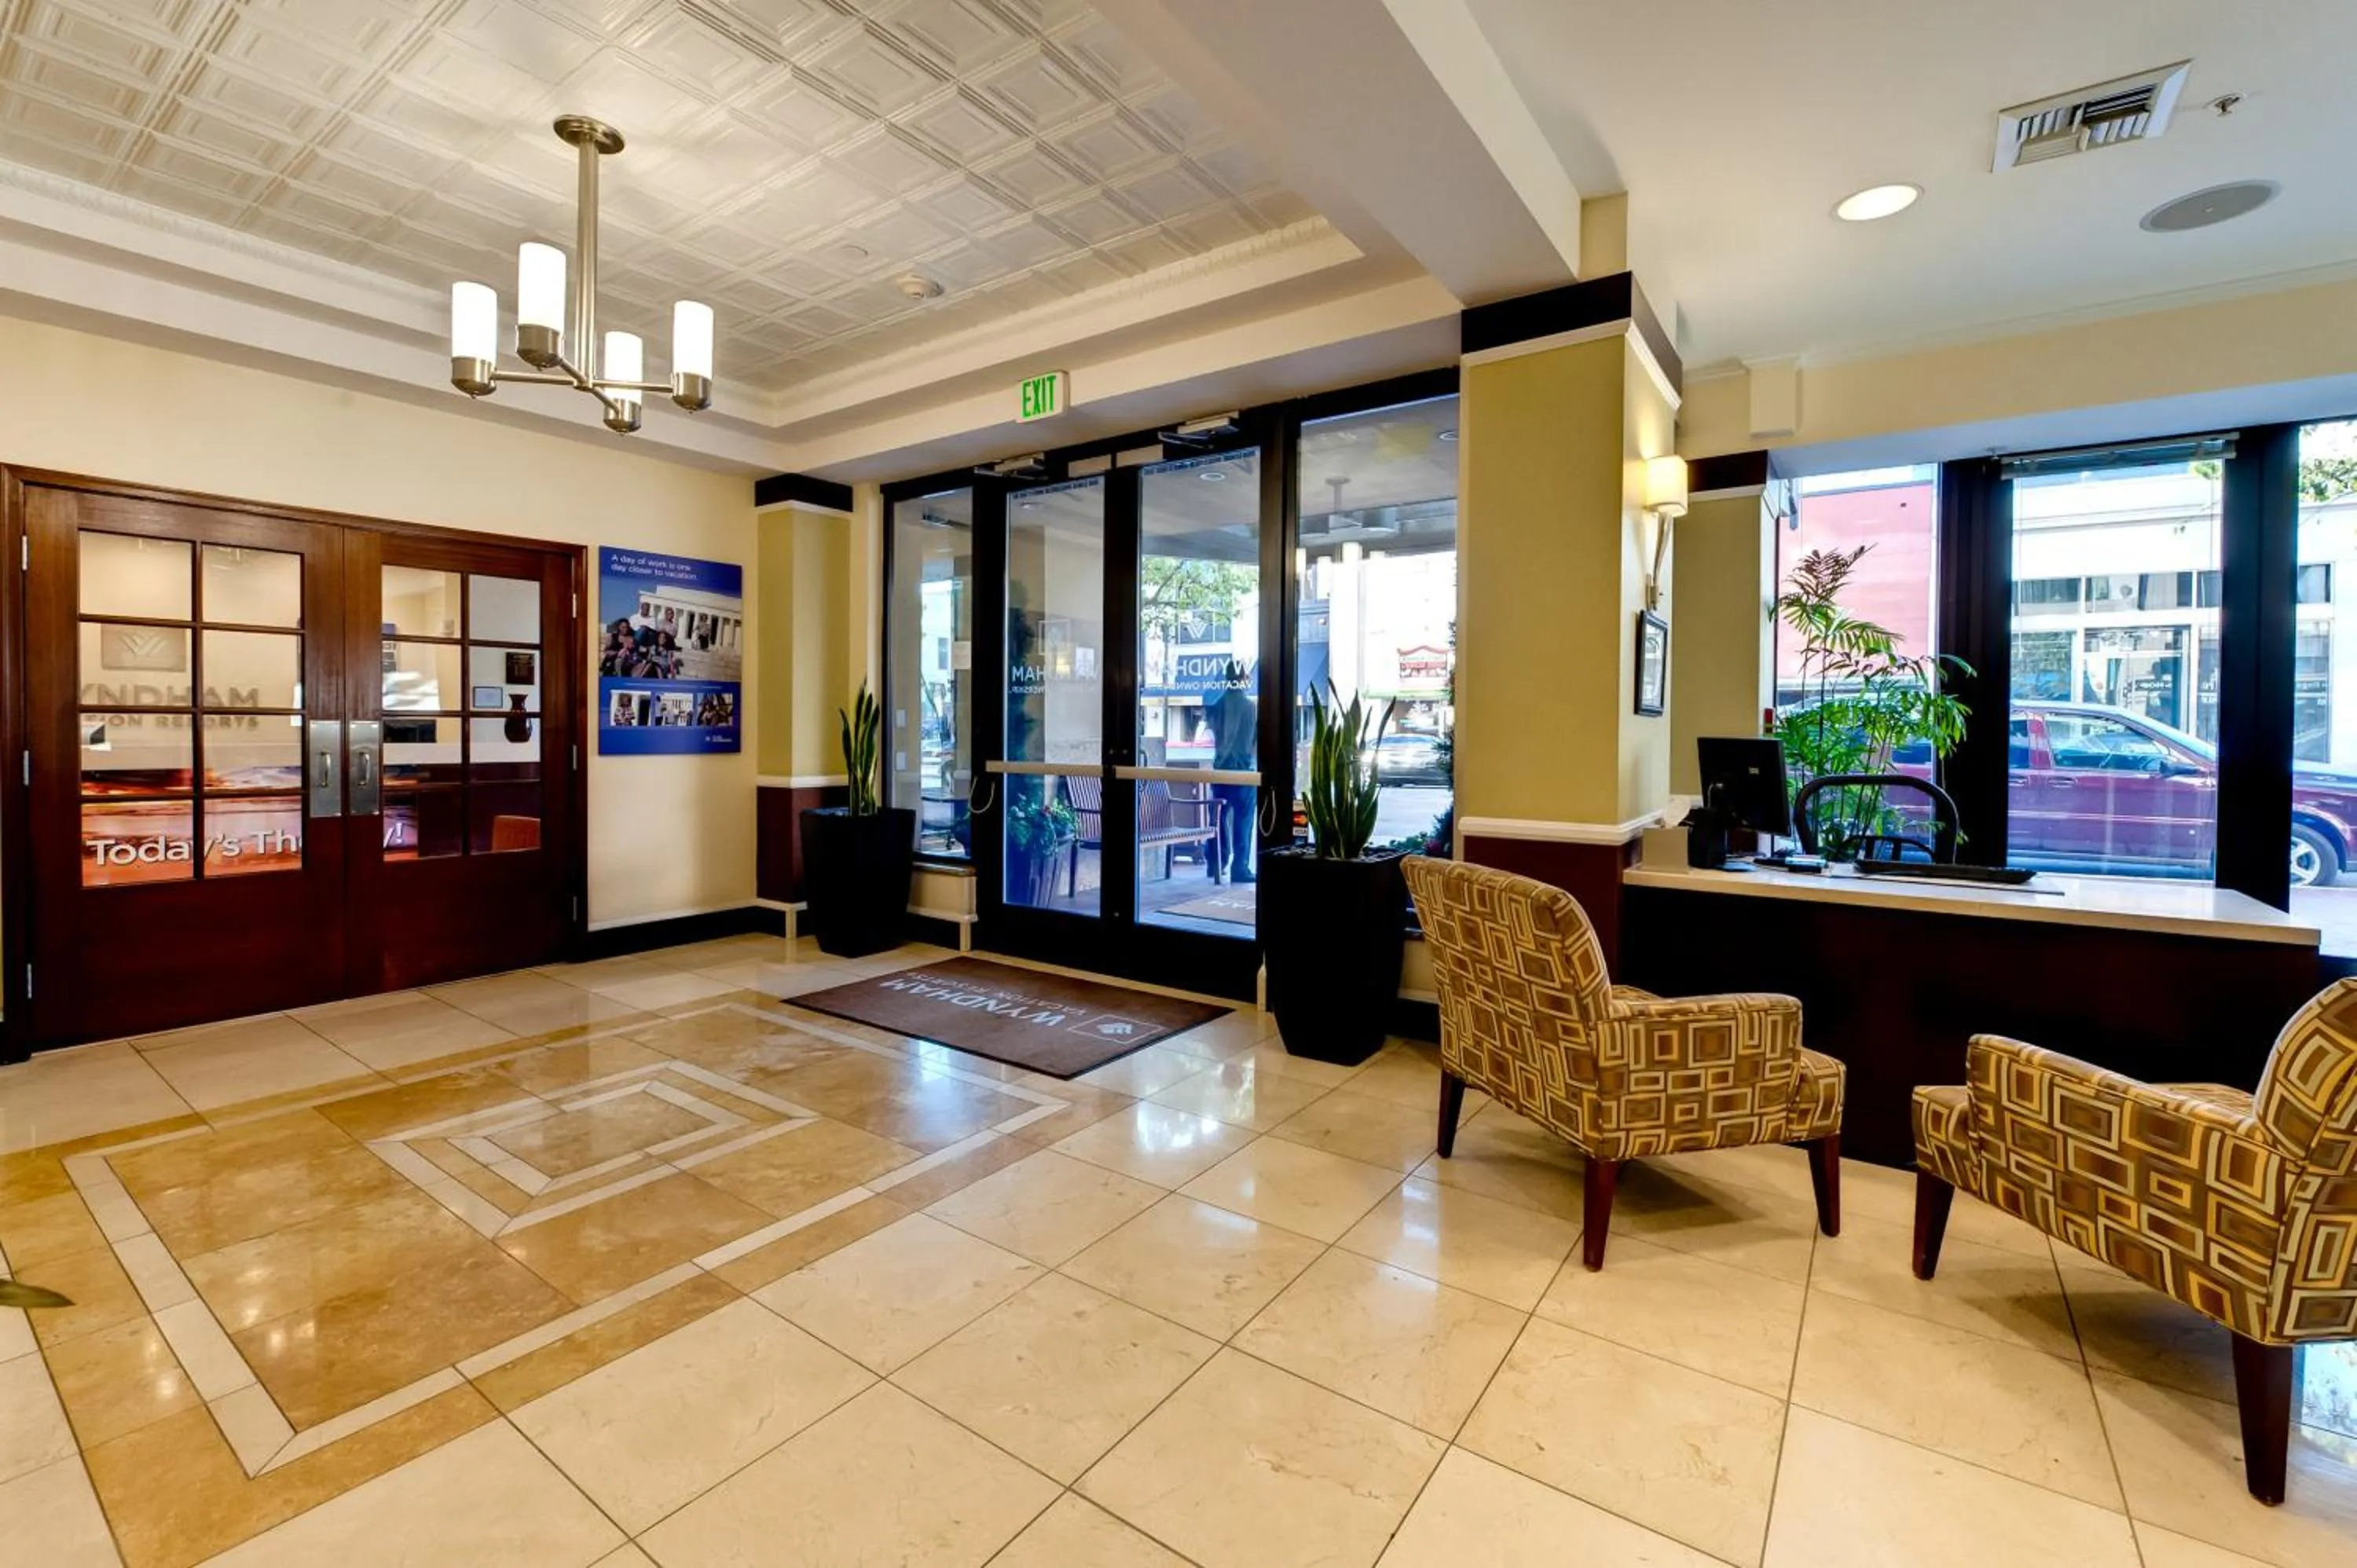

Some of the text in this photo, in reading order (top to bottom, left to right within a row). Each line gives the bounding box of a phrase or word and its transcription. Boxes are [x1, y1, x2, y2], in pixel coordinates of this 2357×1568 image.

[1022, 376, 1057, 418] EXIT
[610, 563, 626, 573] day
[628, 565, 653, 574] closer
[611, 554, 618, 562] A
[620, 555, 636, 565] day
[80, 683, 258, 707] NDHAM
[156, 715, 258, 731] REORTS
[249, 829, 302, 855] Th
[880, 978, 1065, 1027] WYNDHAM
